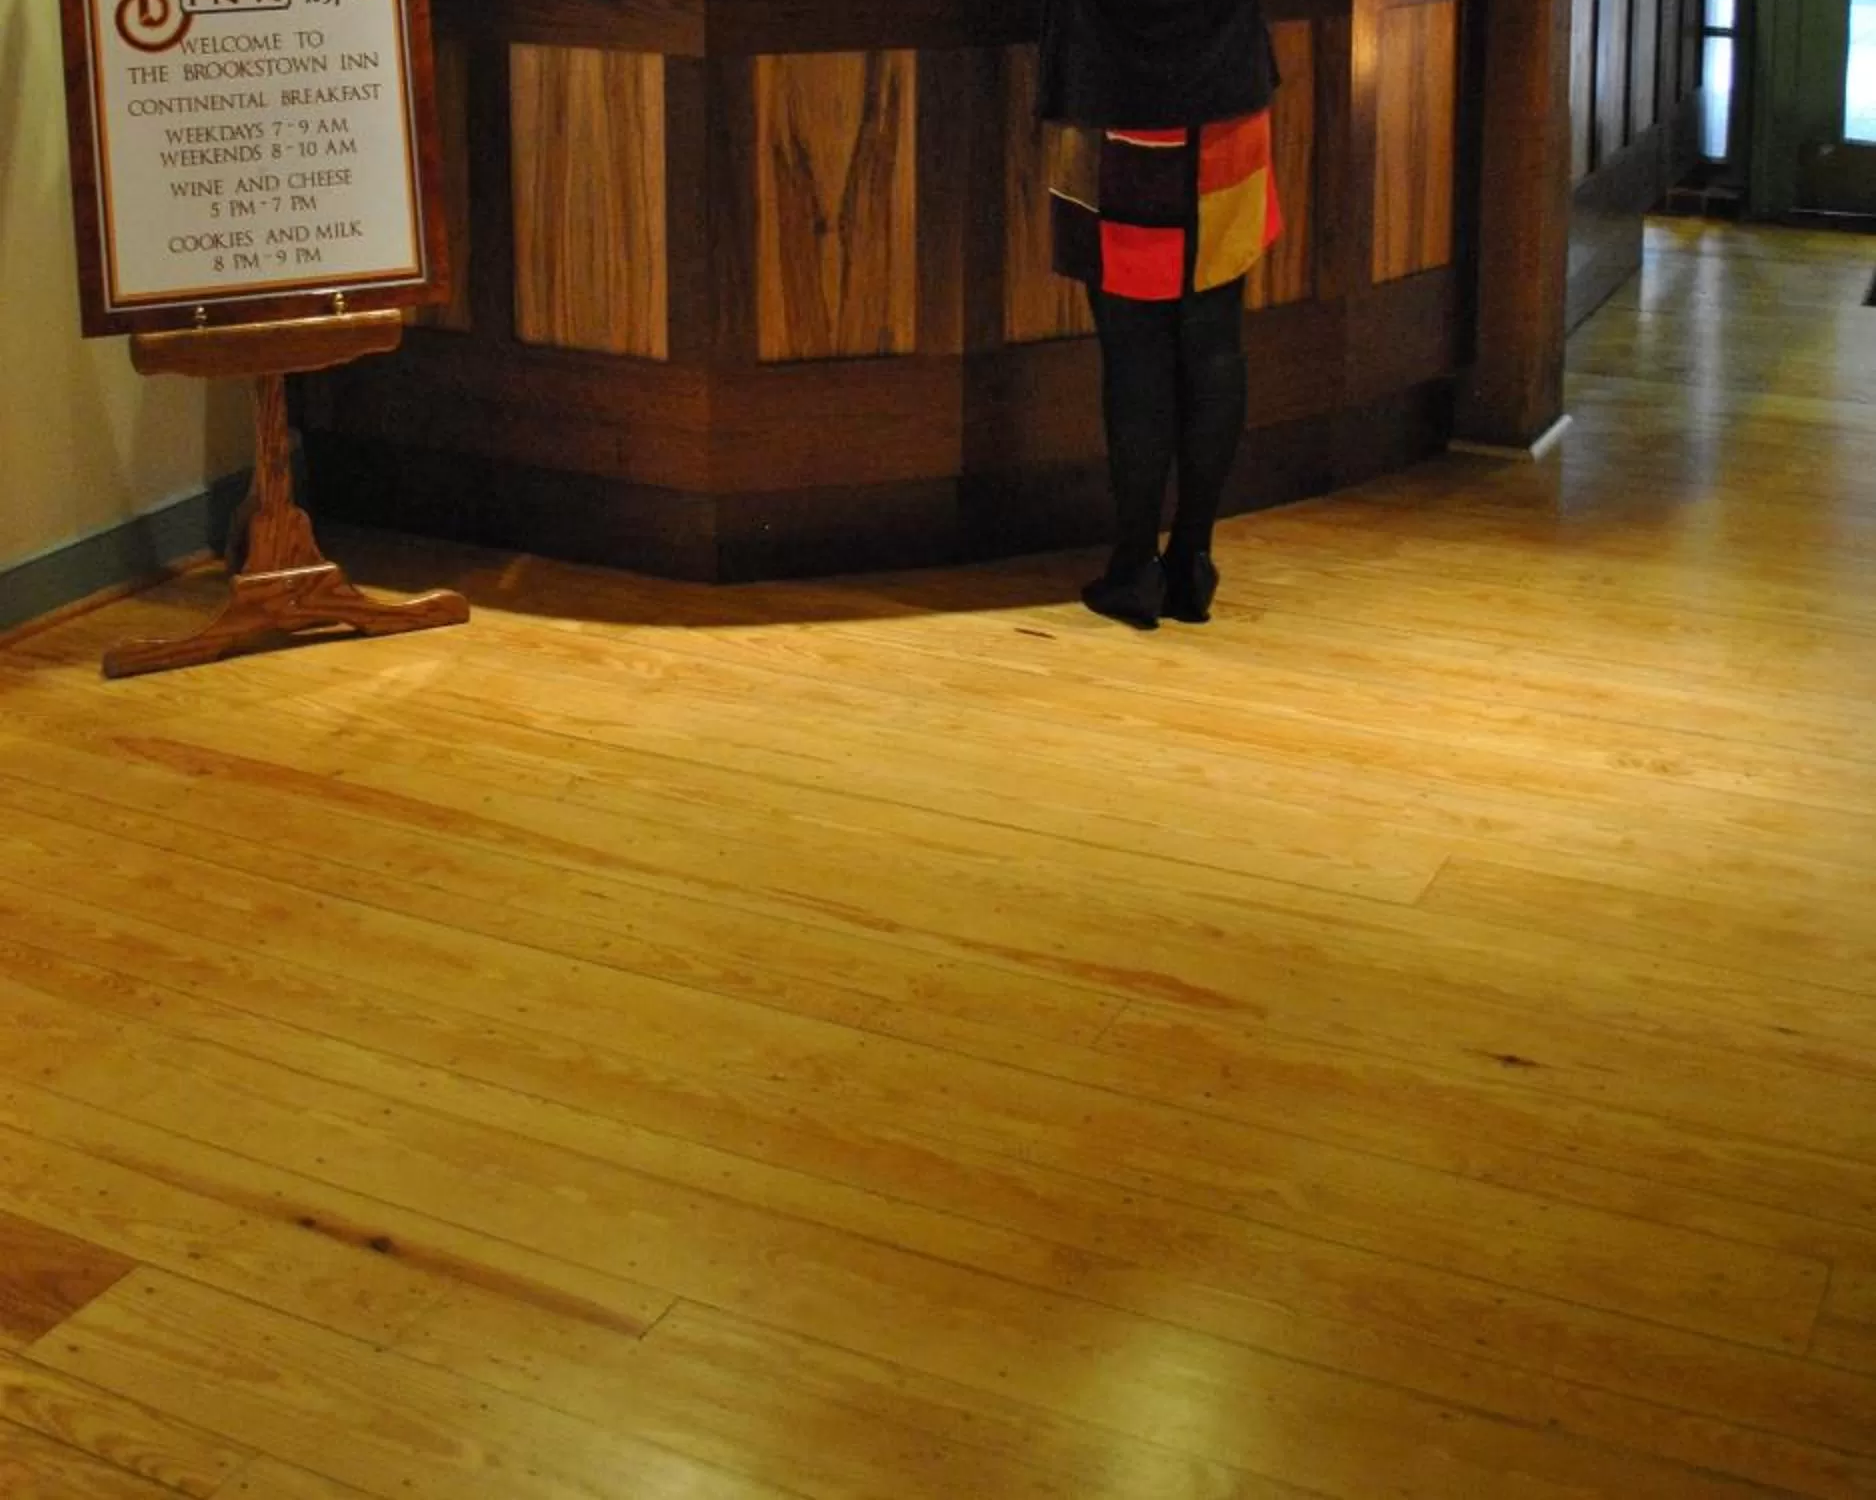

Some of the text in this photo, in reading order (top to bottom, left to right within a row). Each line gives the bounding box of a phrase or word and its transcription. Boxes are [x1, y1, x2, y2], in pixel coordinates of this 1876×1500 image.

[179, 30, 325, 56] WELCOME TO
[128, 52, 380, 85] THE BROOKSTOWN INN
[127, 83, 382, 117] CONTINENTAL BREAKFAST
[164, 122, 264, 146] WEEKDAYS
[317, 117, 349, 134] AM
[159, 144, 262, 168] WEEKENDS
[325, 139, 358, 157] AM
[170, 168, 353, 198] WINE AND CHEESE
[210, 203, 221, 219] 5
[290, 195, 318, 212] PM
[167, 219, 364, 254] COOKIES AND MILK
[213, 255, 225, 272] 8
[295, 247, 322, 264] PM
